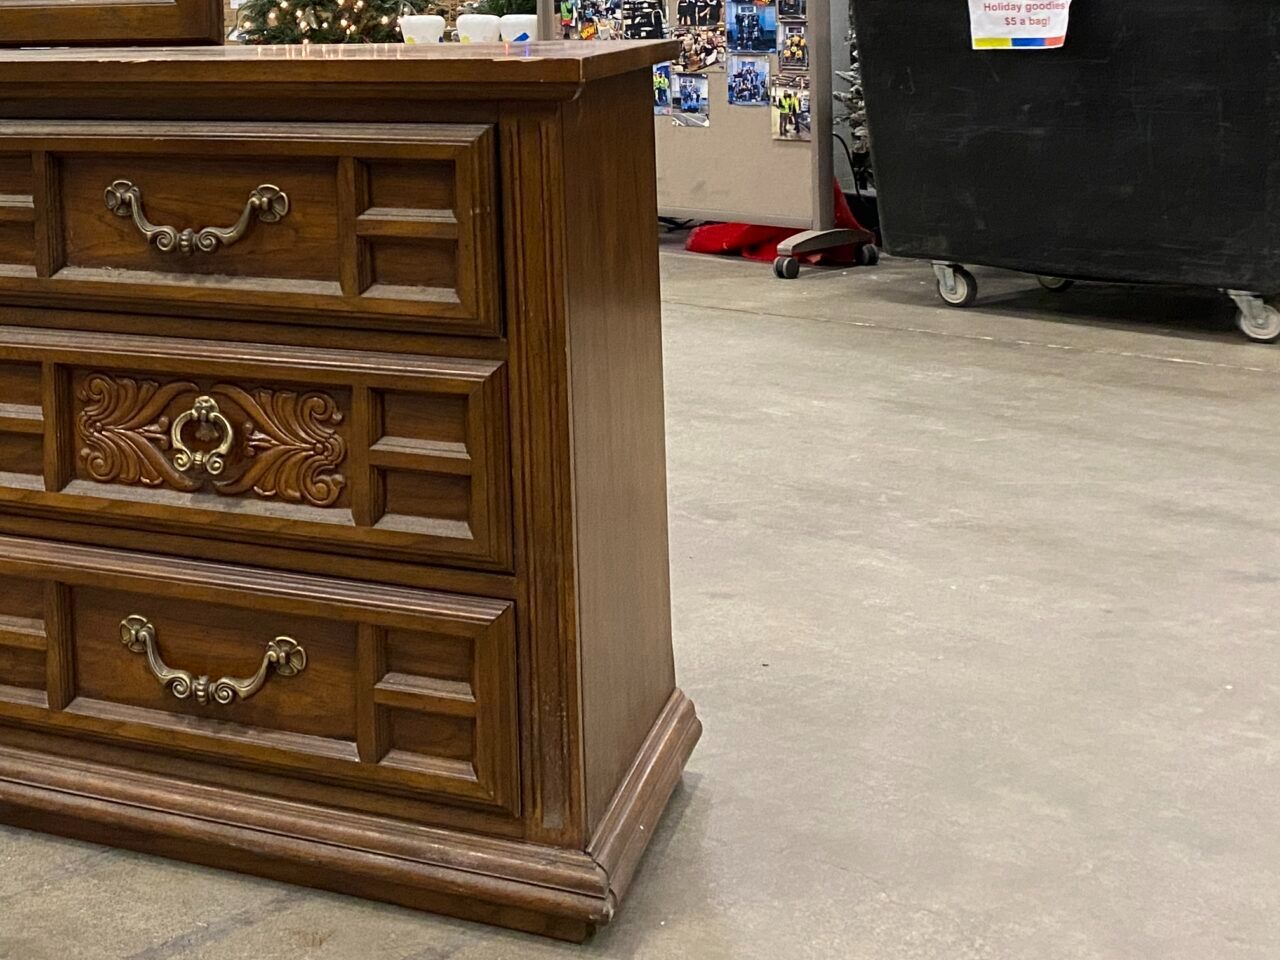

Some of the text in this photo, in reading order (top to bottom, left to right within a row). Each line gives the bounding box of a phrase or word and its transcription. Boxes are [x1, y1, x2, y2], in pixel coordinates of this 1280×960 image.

[983, 3, 1022, 13] Holiday
[1004, 16, 1017, 26] $5
[1029, 16, 1051, 27] bag!
